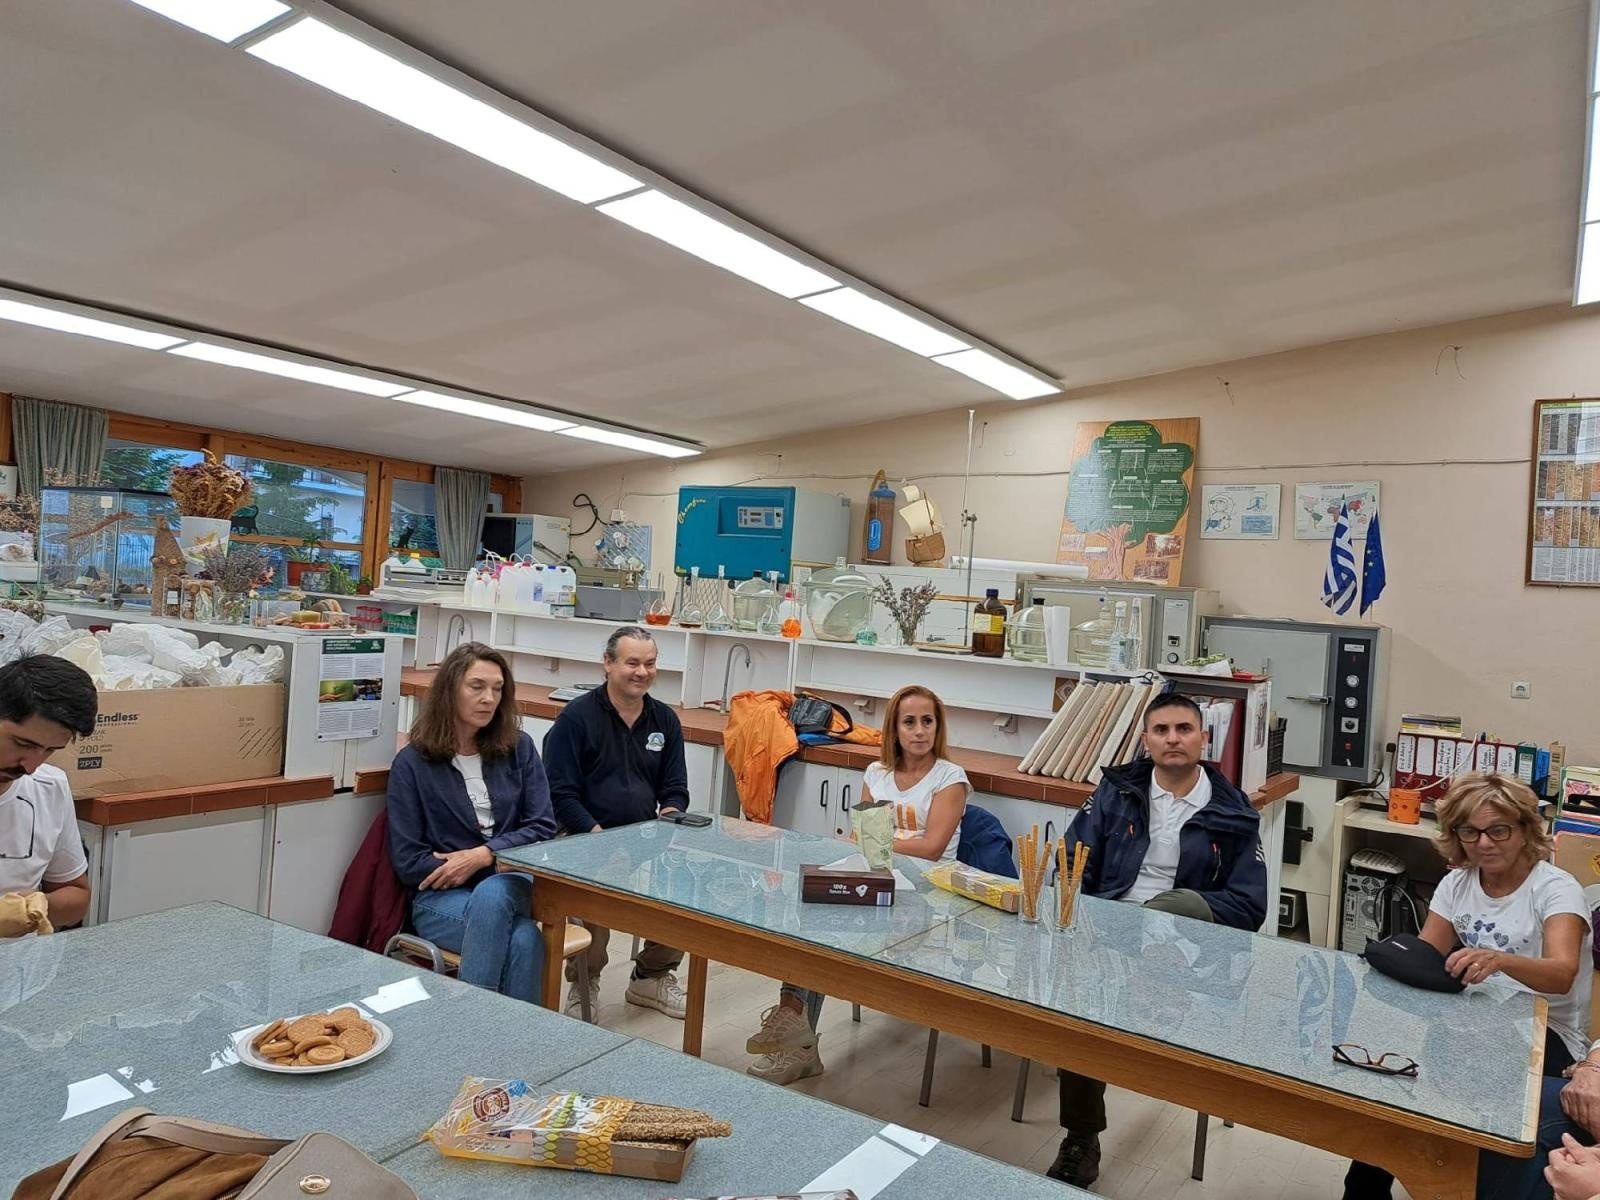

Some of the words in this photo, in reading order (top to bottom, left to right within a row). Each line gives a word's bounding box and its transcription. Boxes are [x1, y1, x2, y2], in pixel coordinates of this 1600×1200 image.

[97, 712, 138, 723] Endless
[80, 745, 99, 754] 200
[79, 758, 101, 767] 2PLY
